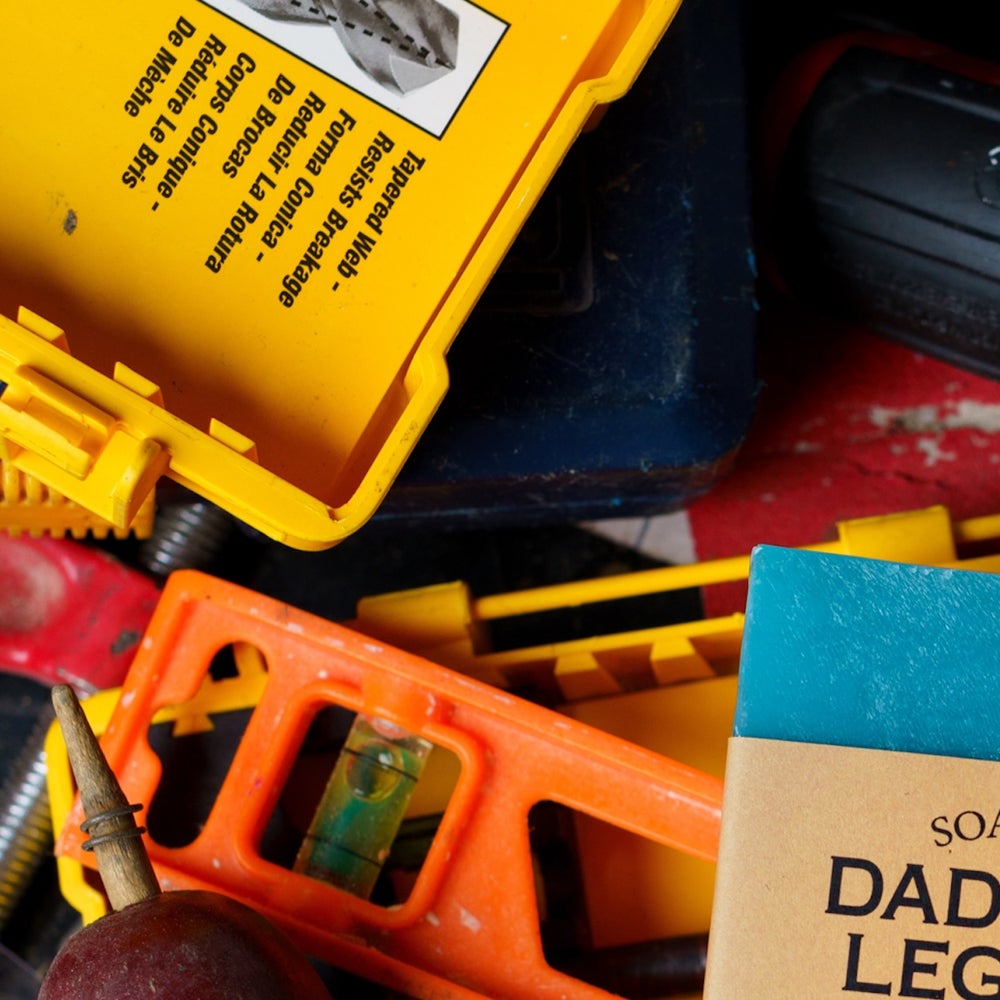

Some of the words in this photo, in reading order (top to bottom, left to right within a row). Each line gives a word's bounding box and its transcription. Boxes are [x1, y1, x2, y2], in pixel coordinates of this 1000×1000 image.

[168, 16, 196, 47] De
[124, 46, 178, 117] Mèche
[167, 33, 226, 115] Réduire
[210, 52, 256, 113] Corps
[268, 73, 296, 105] De
[150, 114, 177, 143] Le
[157, 113, 218, 199] Conique
[222, 104, 277, 179] Brocas
[268, 91, 326, 174] Reducir
[305, 108, 357, 177] Forma
[122, 142, 159, 189] Bris
[249, 172, 276, 202] La
[339, 131, 395, 208] Resists
[366, 150, 426, 235] Tapered
[205, 201, 258, 274] Rotura
[261, 177, 315, 249] Conica
[279, 208, 348, 308] Breakage
[337, 231, 376, 278] Web
